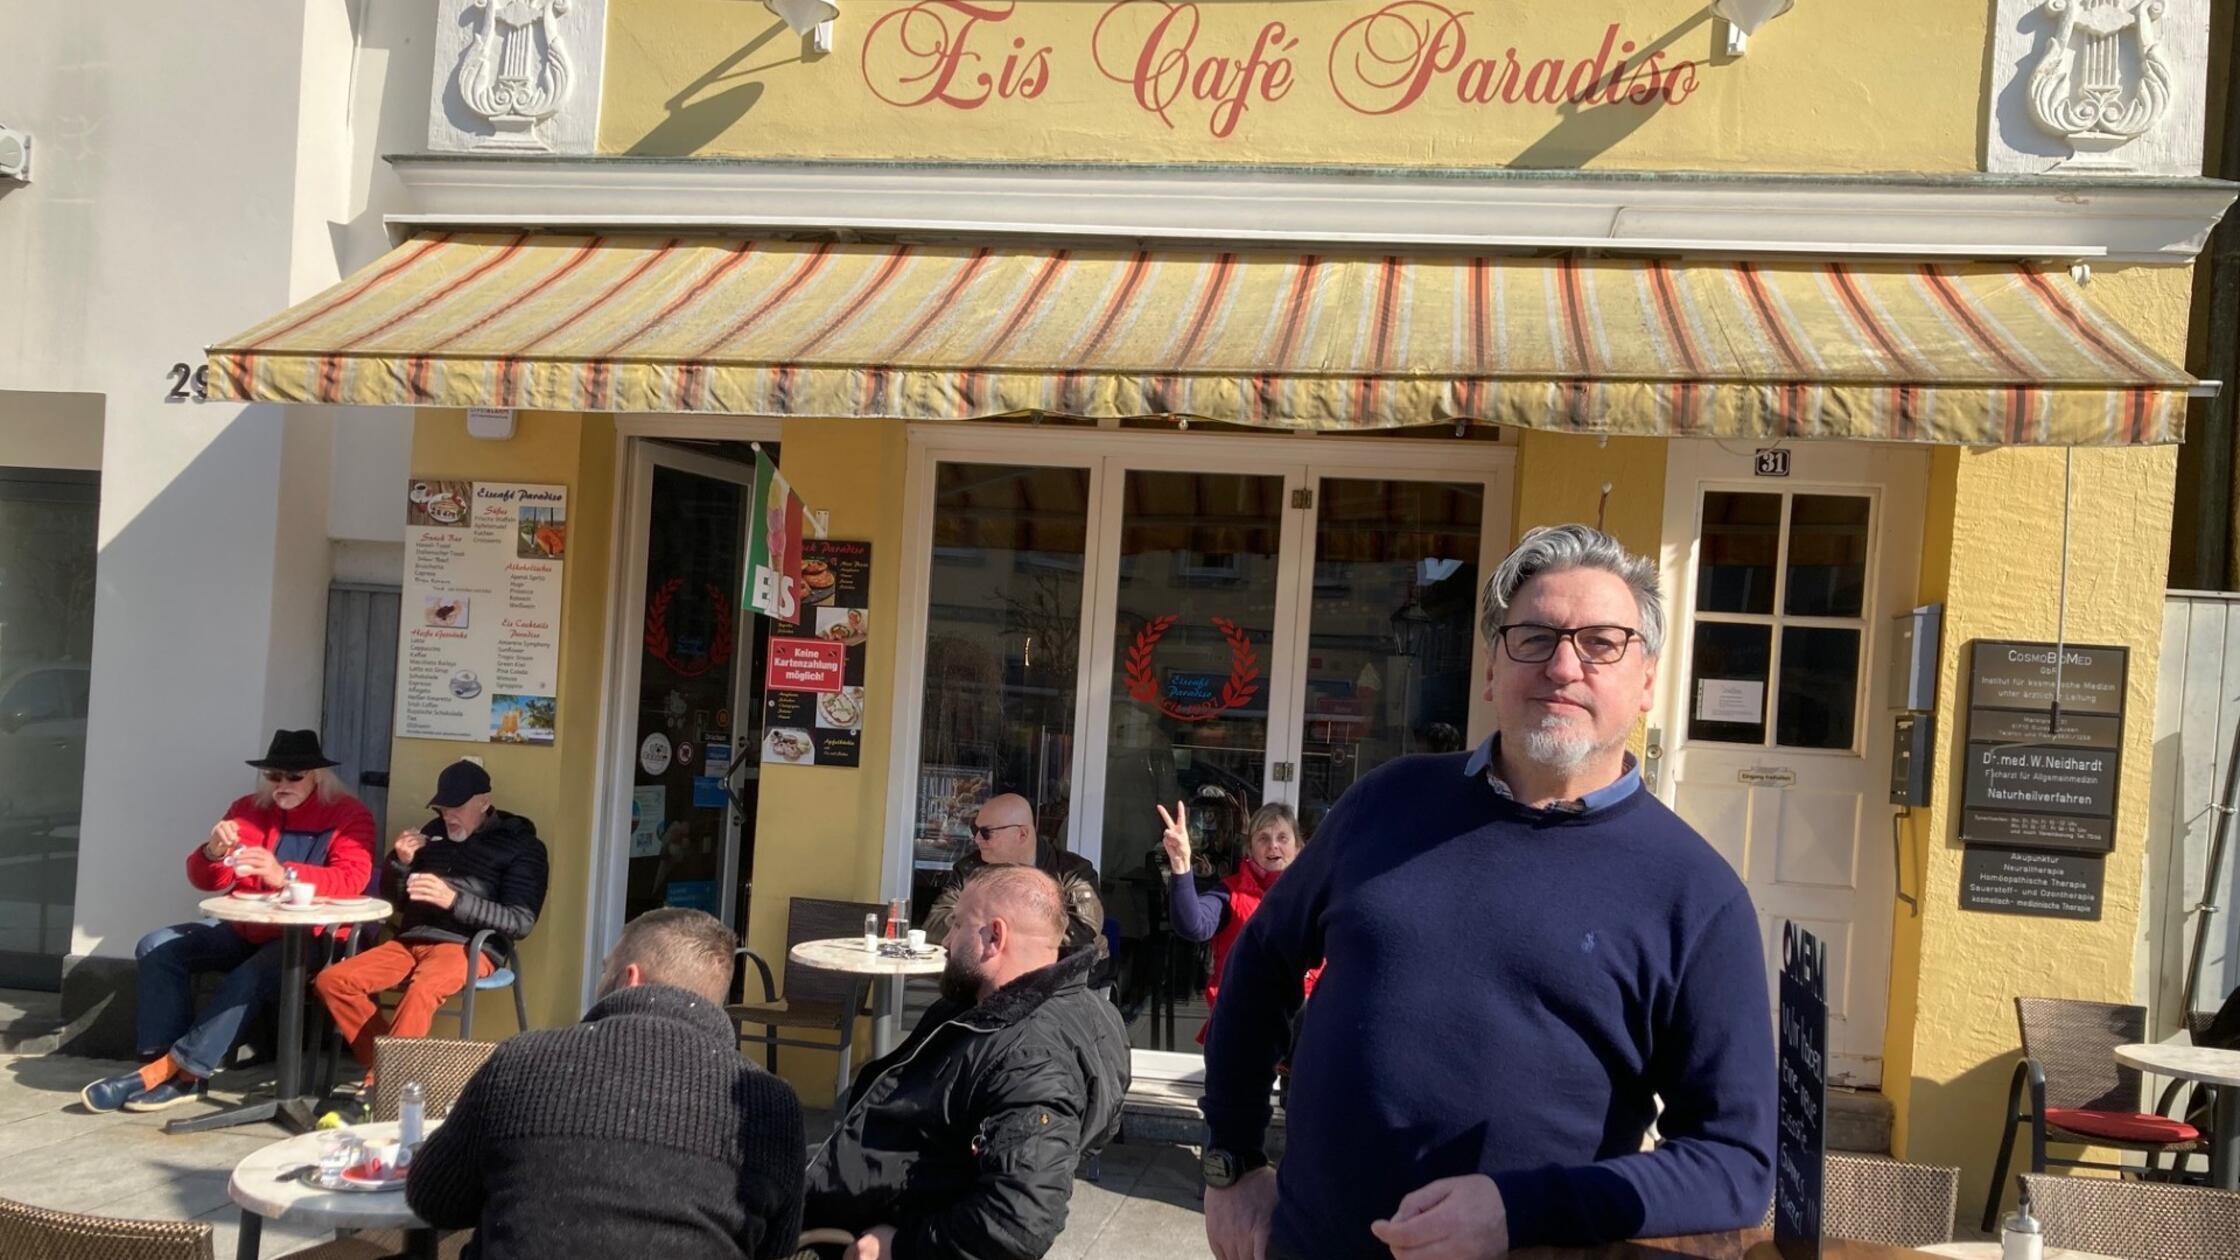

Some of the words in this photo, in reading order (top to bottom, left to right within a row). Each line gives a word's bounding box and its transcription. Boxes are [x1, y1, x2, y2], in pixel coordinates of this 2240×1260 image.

[862, 0, 1053, 109] Eis
[1092, 0, 1299, 138] Café
[1329, 0, 1700, 115] Paradiso
[1762, 452, 1783, 472] 31
[752, 564, 795, 619] EIS
[794, 648, 819, 658] Keine
[774, 658, 838, 672] Kartenzahlung
[786, 671, 824, 681] möglich!
[1988, 788, 2092, 804] Naturheilverfahren
[2010, 853, 2060, 864] Akupunktur
[2003, 864, 2064, 876] Neuraltherapie
[1980, 873, 2048, 886] Homöopathische
[2052, 879, 2087, 889] Therapie
[1970, 884, 2018, 894] Sauerstoff-
[2040, 890, 2095, 901] Ozontherapie
[2062, 902, 2091, 912] Therapie
